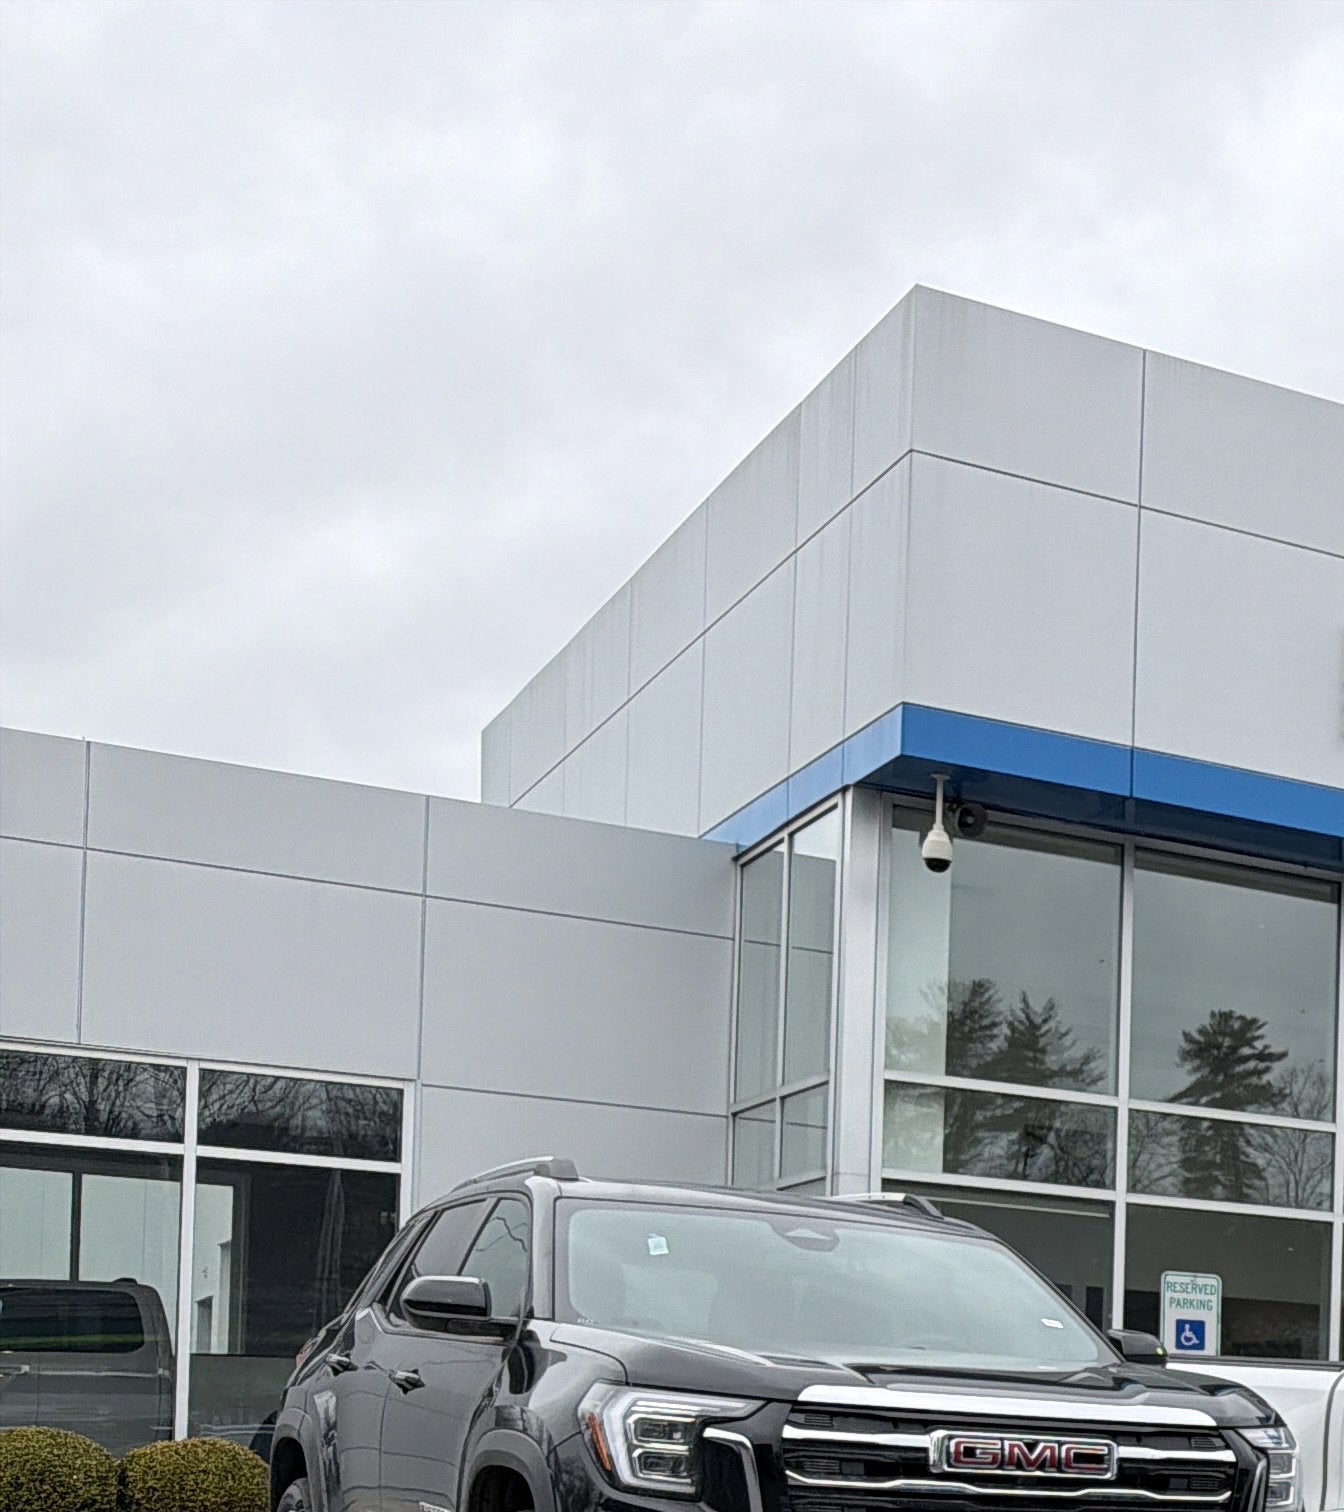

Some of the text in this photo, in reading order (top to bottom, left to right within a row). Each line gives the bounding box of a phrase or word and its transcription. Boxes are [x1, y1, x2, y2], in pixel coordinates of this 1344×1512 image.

[1165, 1281, 1217, 1296] RESERVED
[1168, 1297, 1213, 1312] PARKING
[951, 1437, 1109, 1475] GMC
